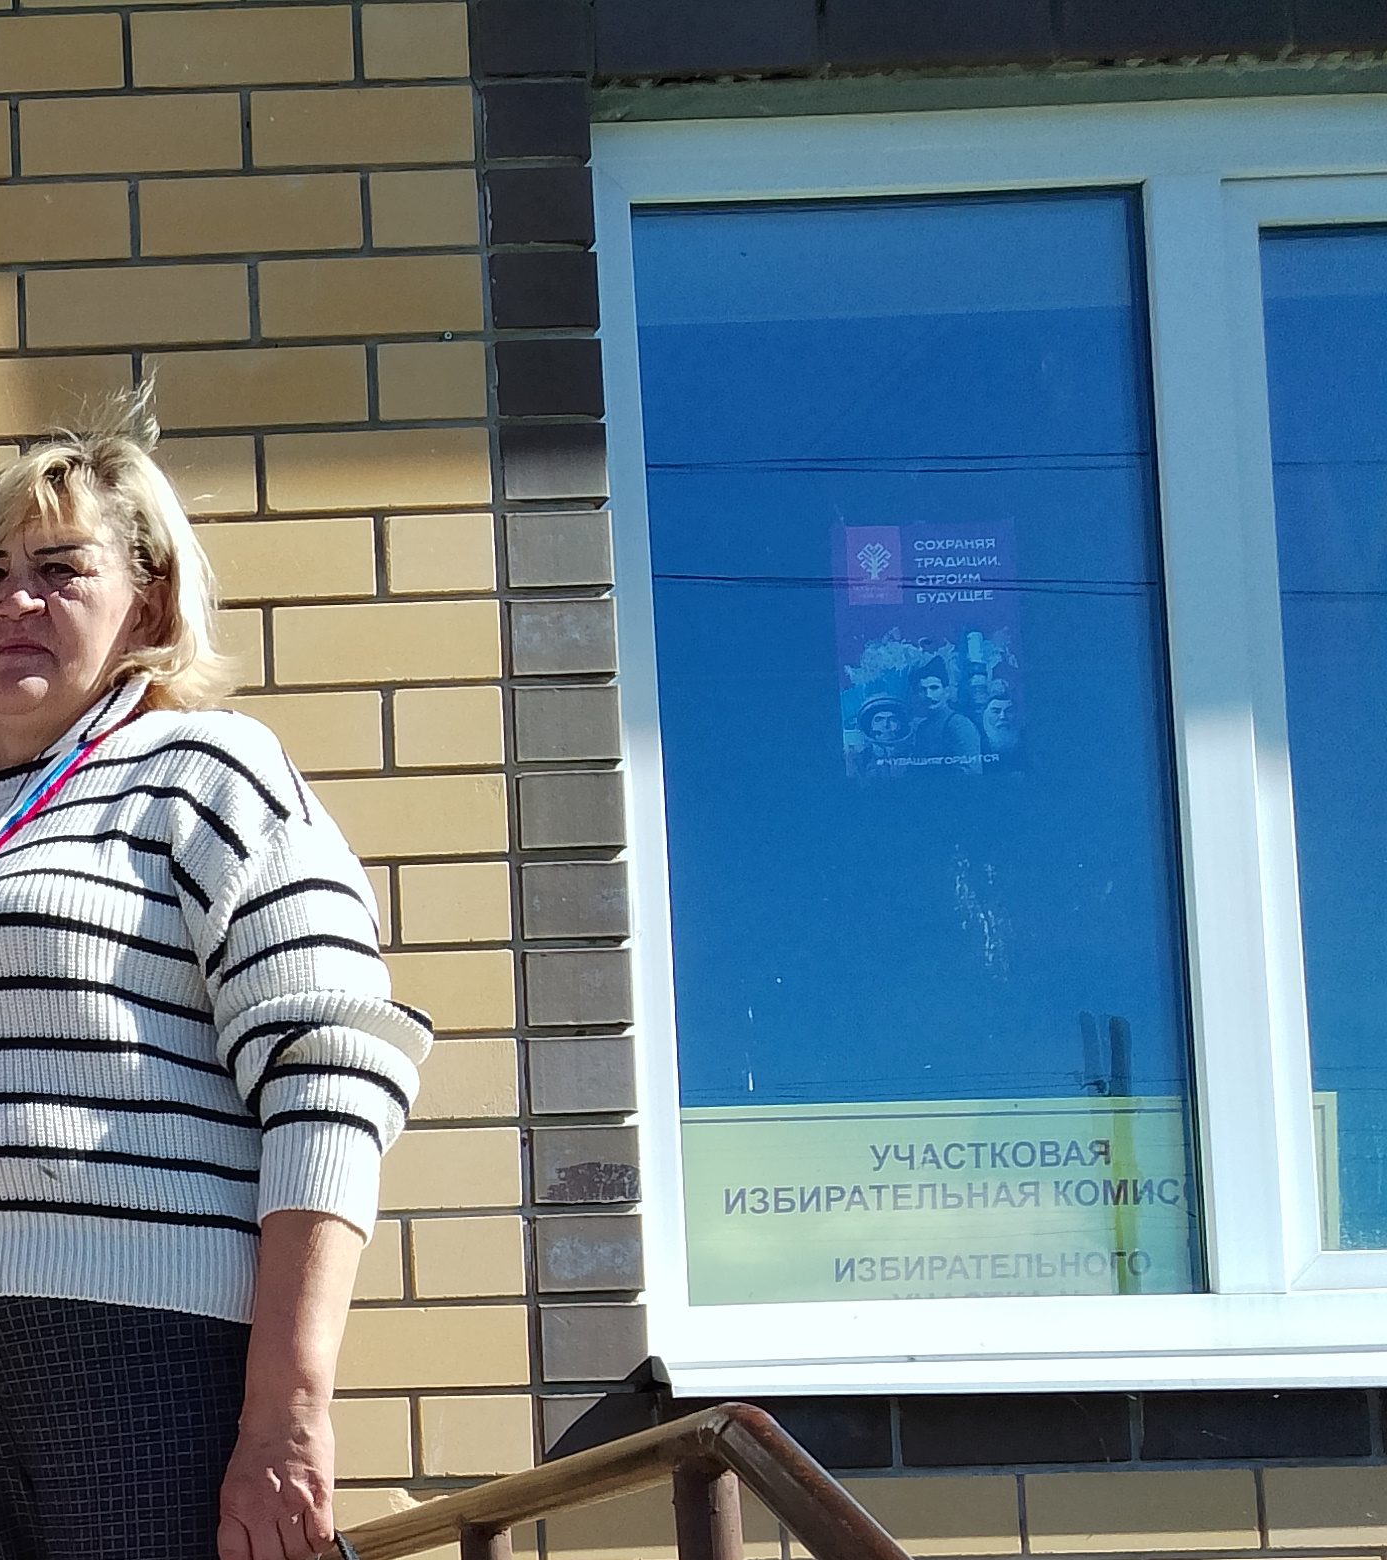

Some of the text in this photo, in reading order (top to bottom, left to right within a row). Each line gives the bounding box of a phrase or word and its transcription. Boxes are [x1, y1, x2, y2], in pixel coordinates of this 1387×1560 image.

[914, 538, 995, 551] СОХРАНЯЯ
[915, 573, 981, 586] СТРОИМ
[916, 590, 994, 604] БУДУЩЕЕ
[870, 1140, 1111, 1172] УЧАСТКОВАЯ
[724, 1178, 1041, 1215] ИЗБИРАТЕЛЬНАЯ
[834, 1250, 1152, 1284] ИЗБИРАТЕЛЬНОГО
